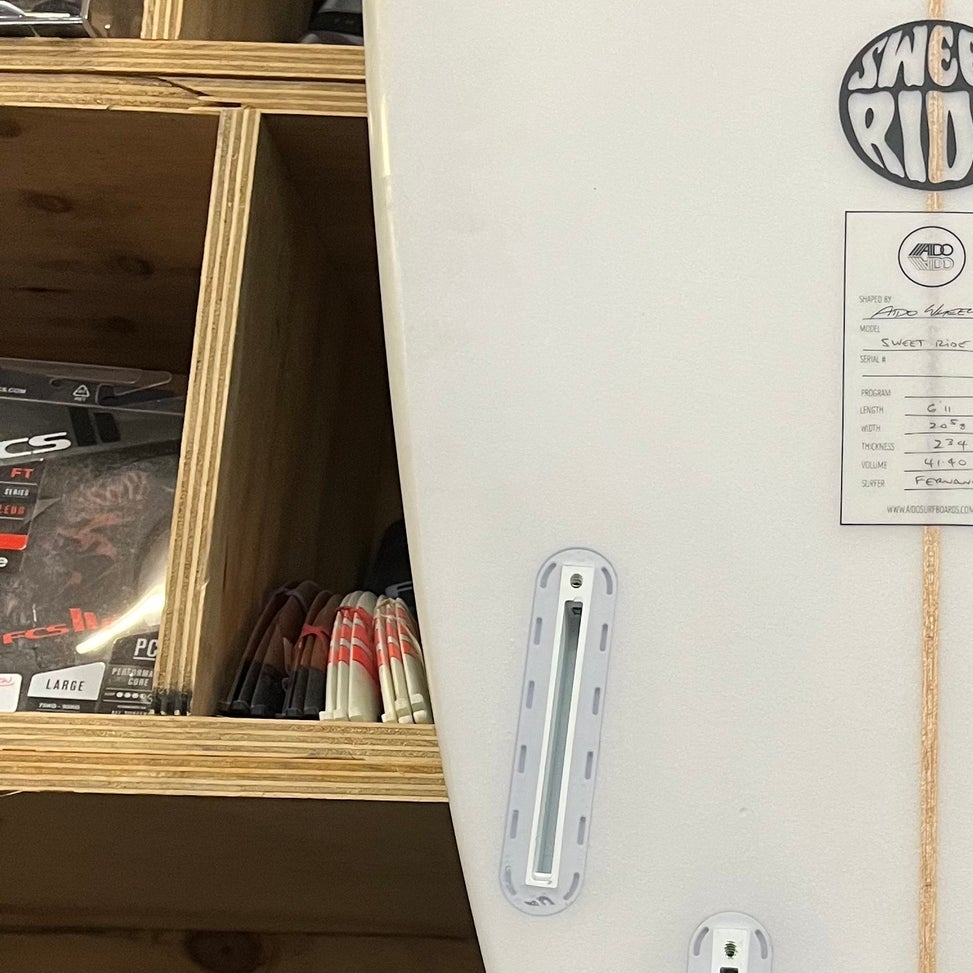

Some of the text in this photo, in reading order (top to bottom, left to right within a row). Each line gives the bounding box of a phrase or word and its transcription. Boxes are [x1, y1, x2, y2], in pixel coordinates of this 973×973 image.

[859, 295, 892, 304] SHAPED BY
[859, 324, 881, 333] MODEL
[881, 338, 926, 348] SWEET
[860, 355, 880, 364] SERIAL
[860, 388, 892, 397] PROGRAM
[860, 405, 884, 415] LENGTH
[861, 424, 881, 433] WIDTH
[861, 442, 896, 451] THICKNESS
[861, 460, 888, 469] VOLUME
[10, 468, 34, 479] FT
[861, 479, 886, 488] SURFER
[2, 623, 69, 645] FCS
[112, 667, 153, 678] PERFORMA
[46, 679, 86, 692] LARGE
